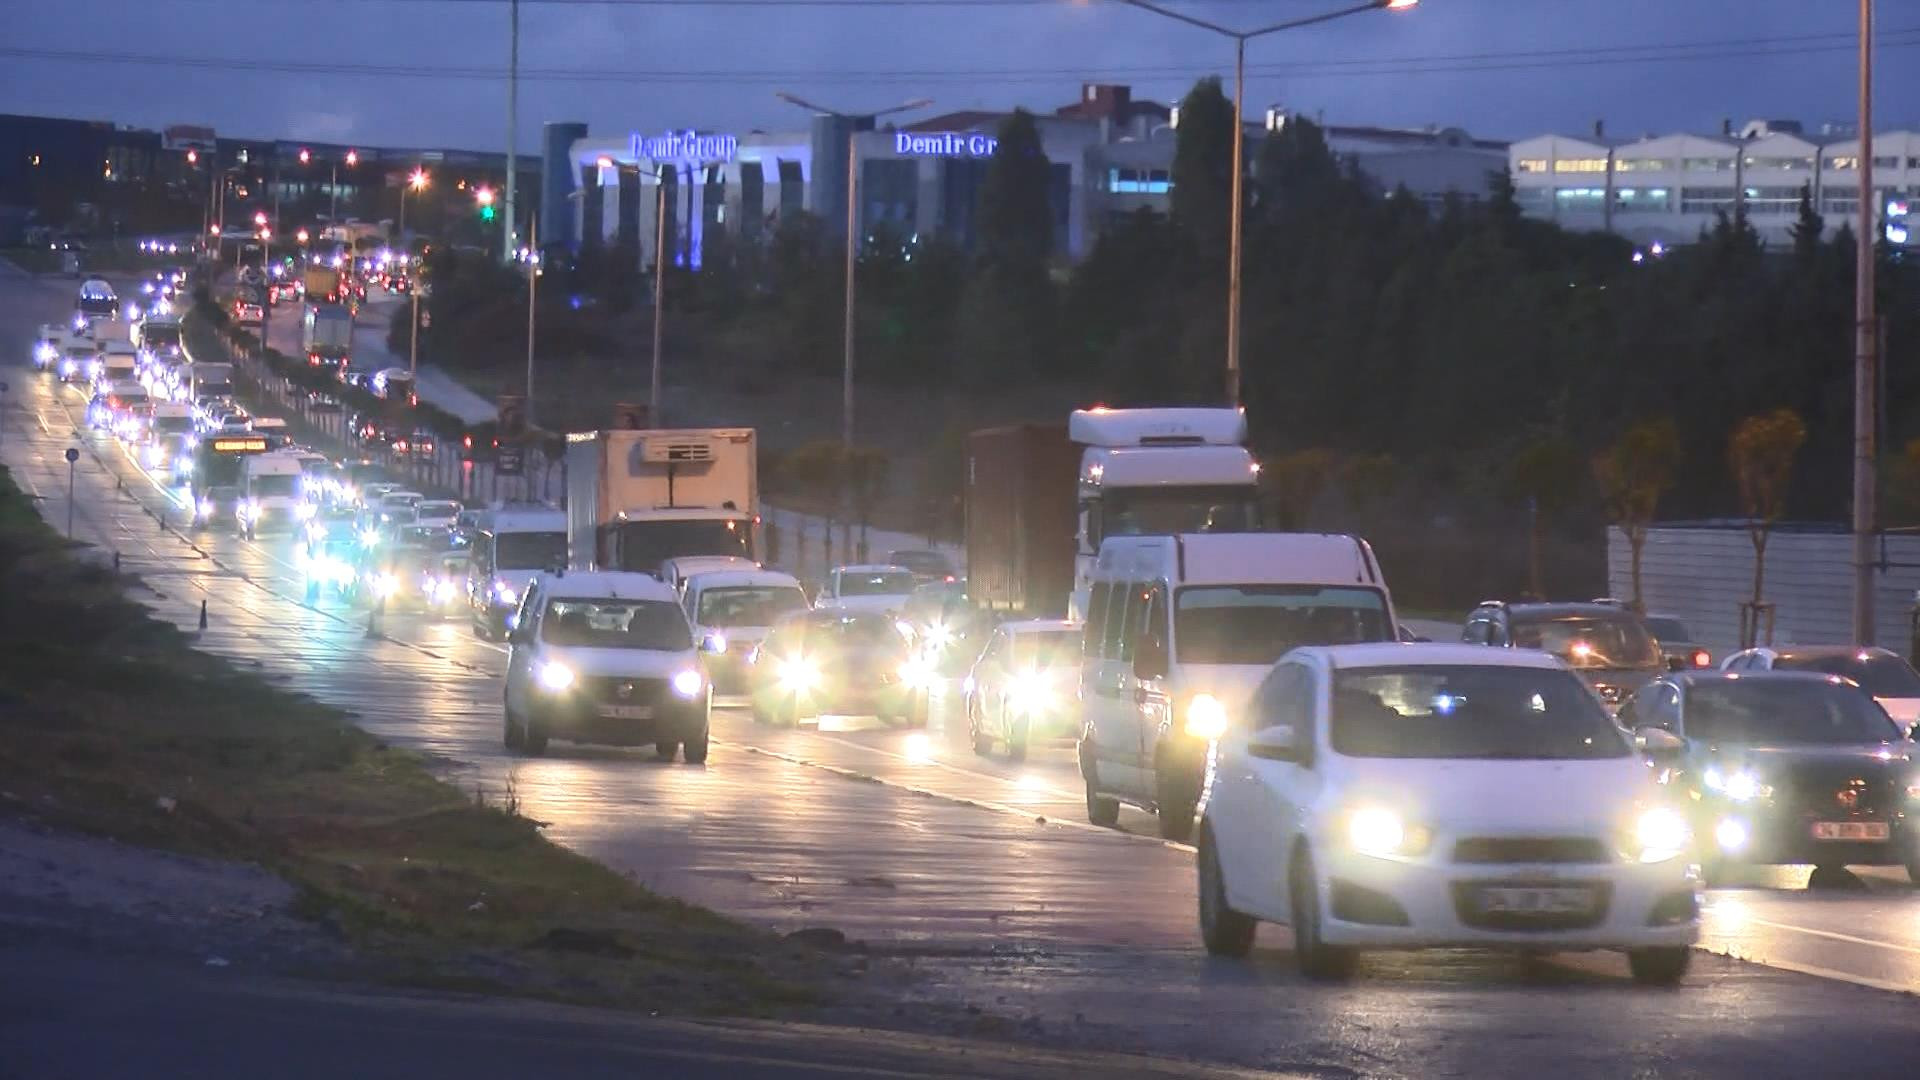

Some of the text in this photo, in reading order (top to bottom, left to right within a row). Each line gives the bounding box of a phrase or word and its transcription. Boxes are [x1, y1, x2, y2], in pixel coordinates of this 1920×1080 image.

[631, 130, 737, 163] Demir Group
[895, 132, 965, 155] Demir
